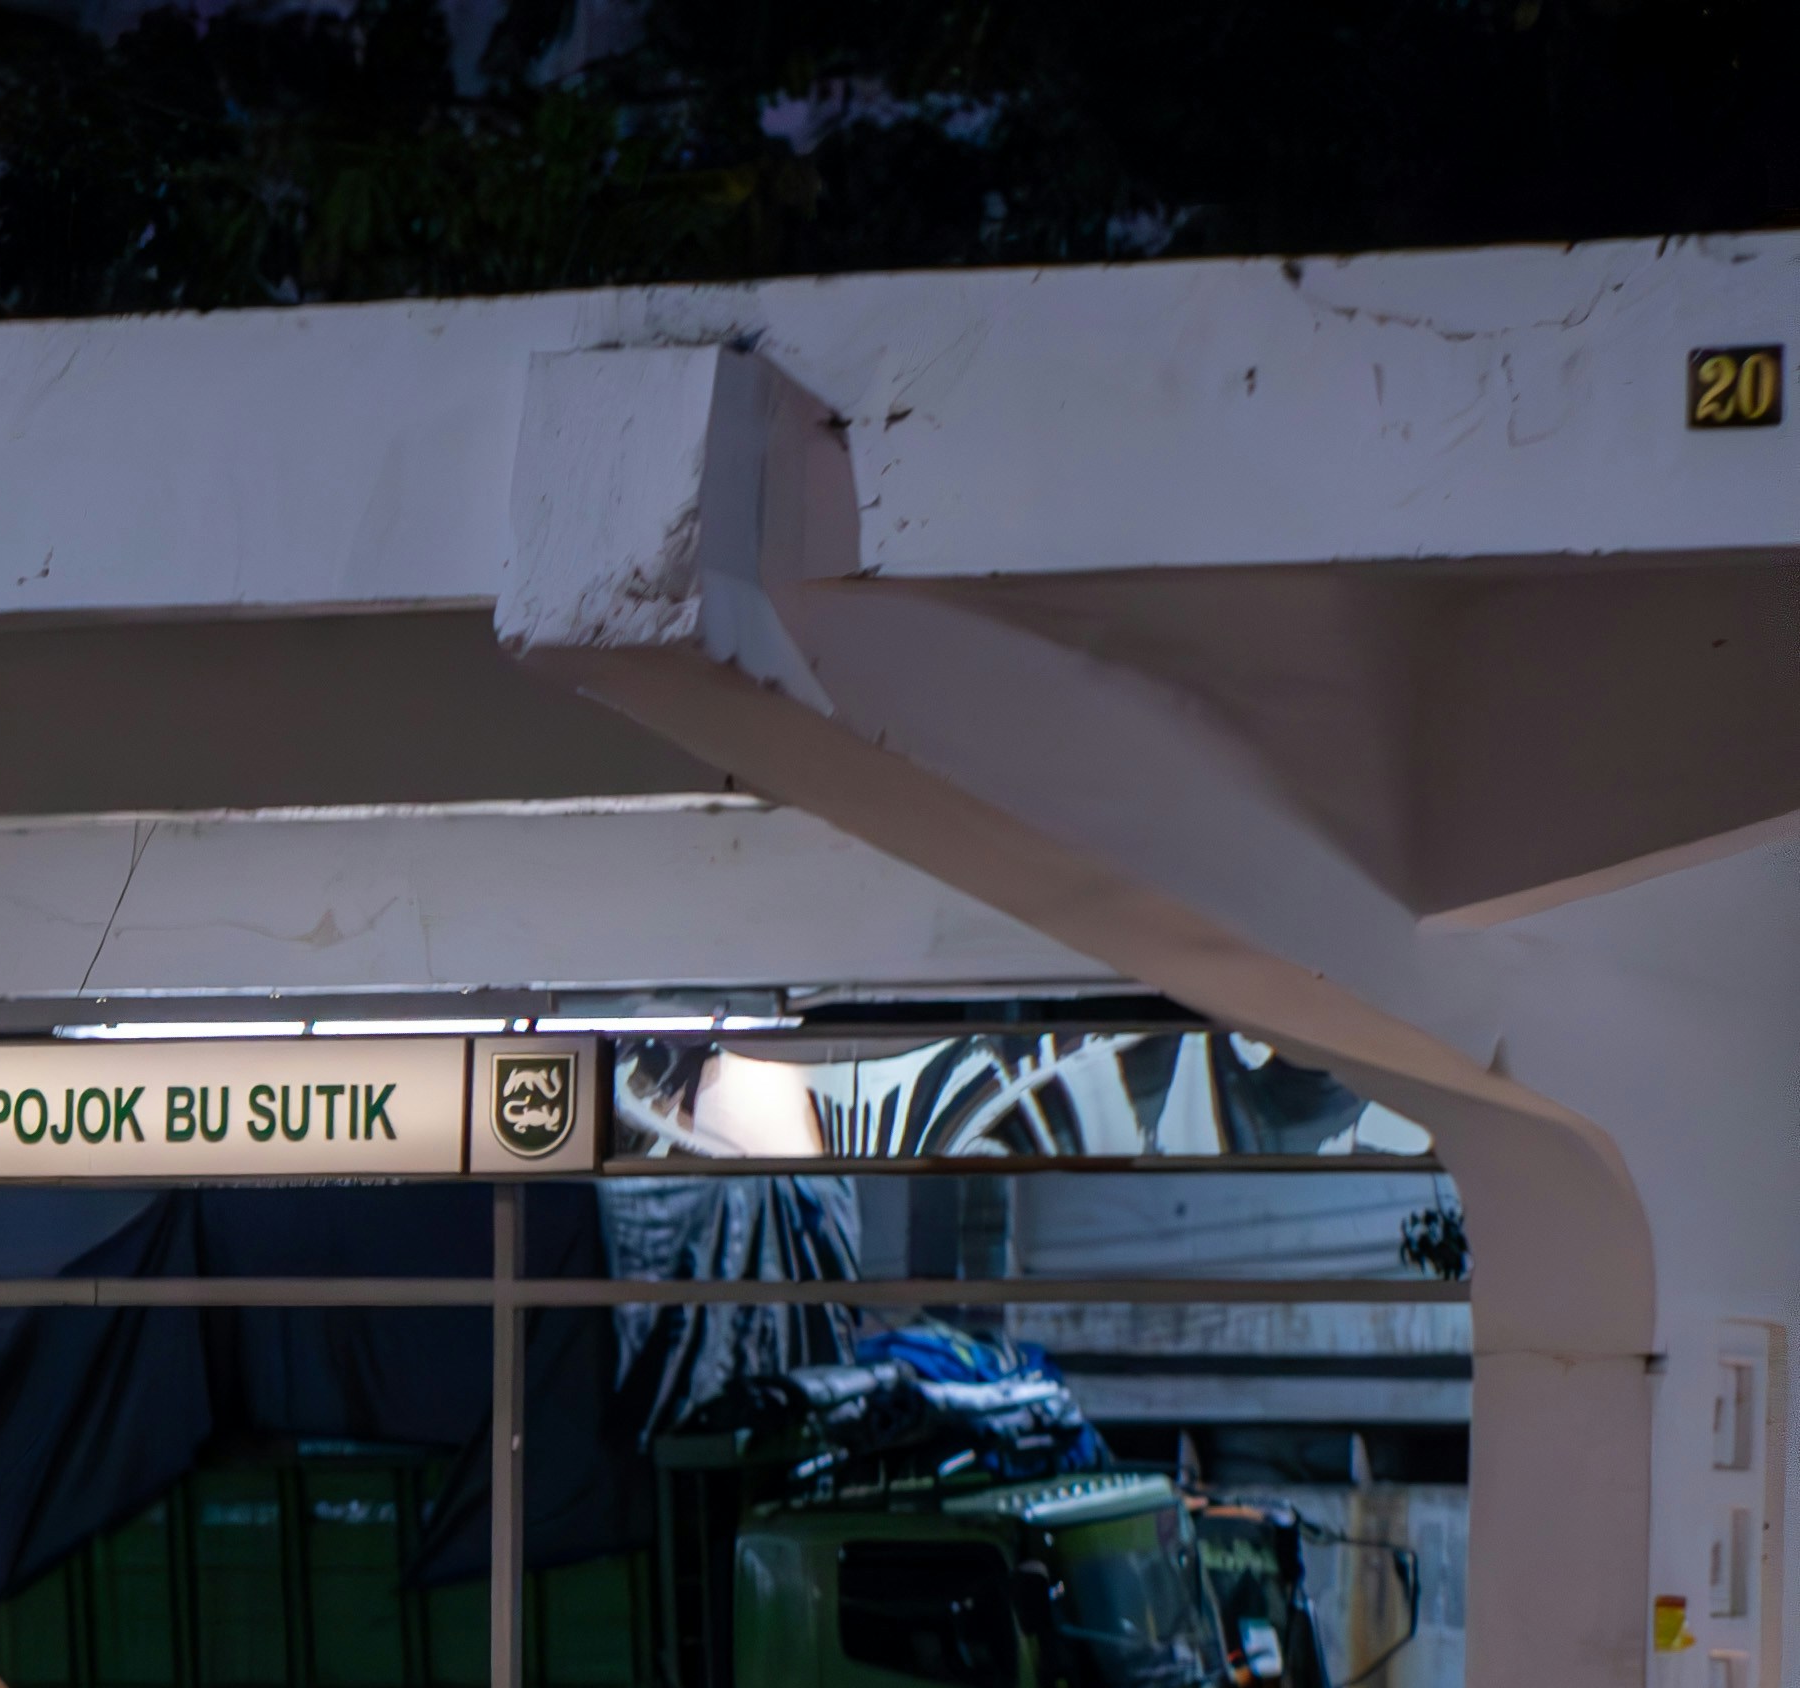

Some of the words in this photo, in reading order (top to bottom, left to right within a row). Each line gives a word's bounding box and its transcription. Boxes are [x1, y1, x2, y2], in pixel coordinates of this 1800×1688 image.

[1696, 353, 1776, 422] 20
[166, 1086, 231, 1142] BU
[247, 1084, 398, 1141] SUTIK
